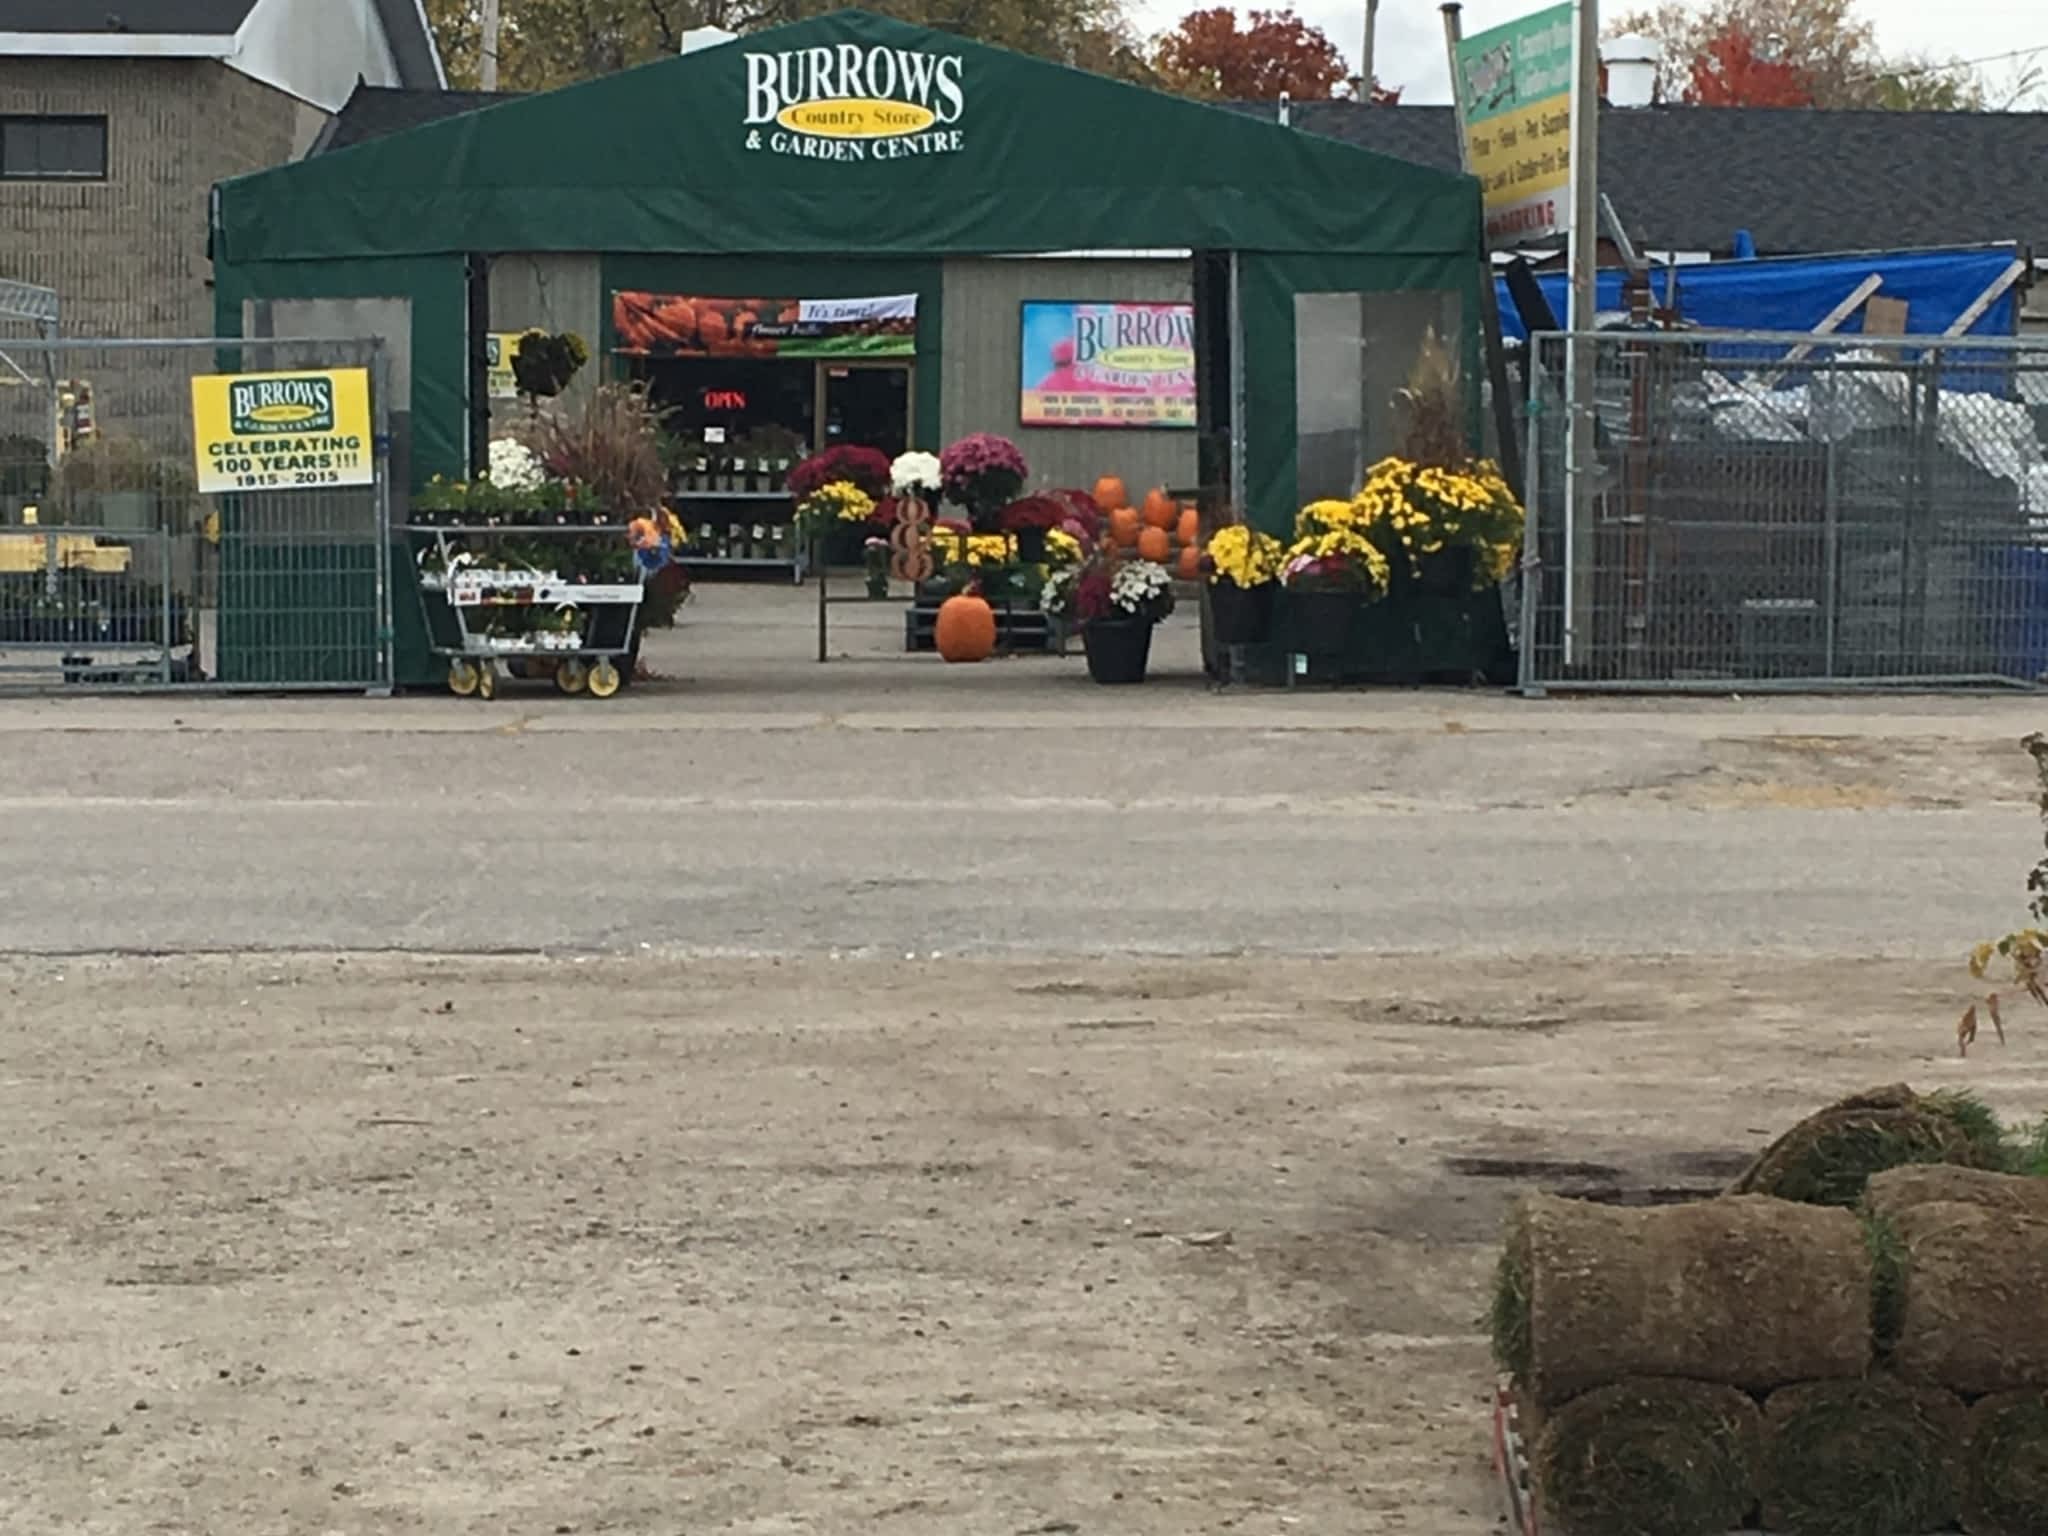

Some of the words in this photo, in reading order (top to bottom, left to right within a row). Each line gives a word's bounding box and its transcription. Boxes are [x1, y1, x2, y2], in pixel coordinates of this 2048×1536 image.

[743, 44, 964, 124] BURROWS
[791, 109, 865, 130] Country
[874, 109, 921, 125] Store
[745, 129, 761, 150] &
[770, 132, 865, 161] GARDEN
[872, 131, 965, 159] CENTRE
[234, 380, 329, 417] BURROWS
[704, 391, 745, 409] OPEN
[208, 436, 361, 456] CELEBRATING
[212, 458, 252, 473] 100
[235, 473, 278, 486] 1915
[295, 471, 339, 484] 2015
